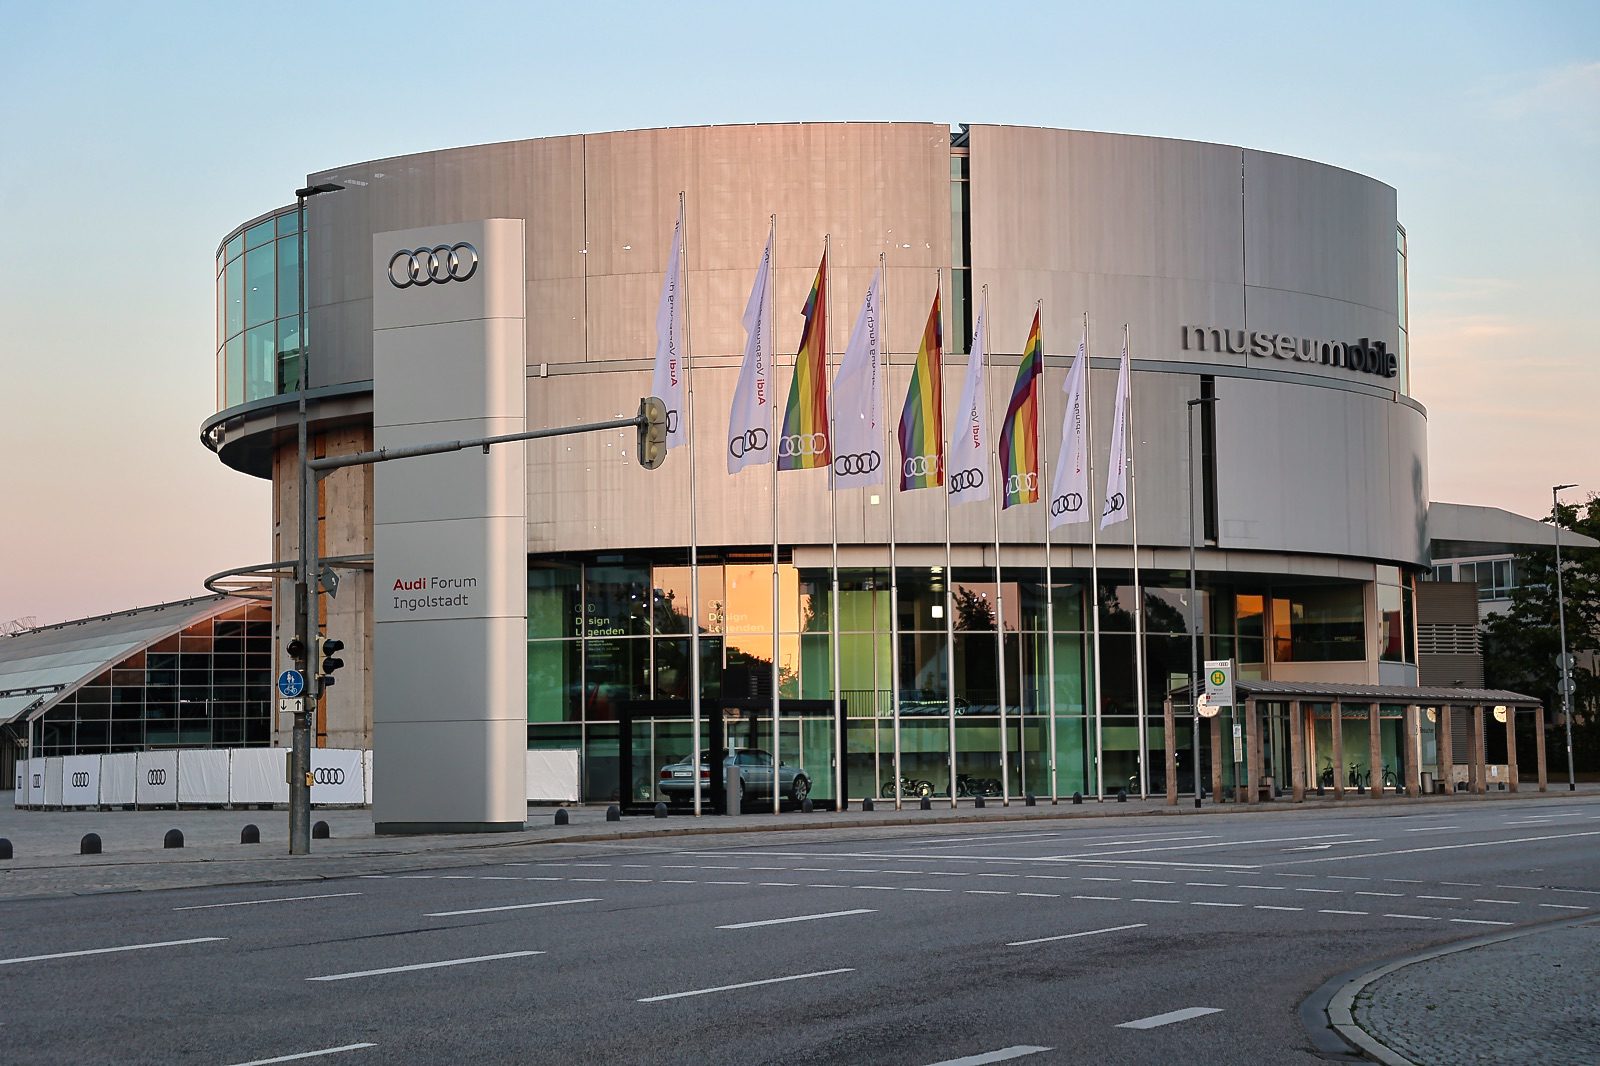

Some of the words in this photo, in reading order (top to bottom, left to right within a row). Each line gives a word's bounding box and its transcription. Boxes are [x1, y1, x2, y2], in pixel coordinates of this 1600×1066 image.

[393, 578, 426, 591] Audi
[431, 577, 477, 589] Forum
[393, 594, 468, 611] Ingolstadt
[575, 616, 610, 627] Dsign
[708, 612, 748, 622] Deign
[575, 627, 625, 637] Lgenden
